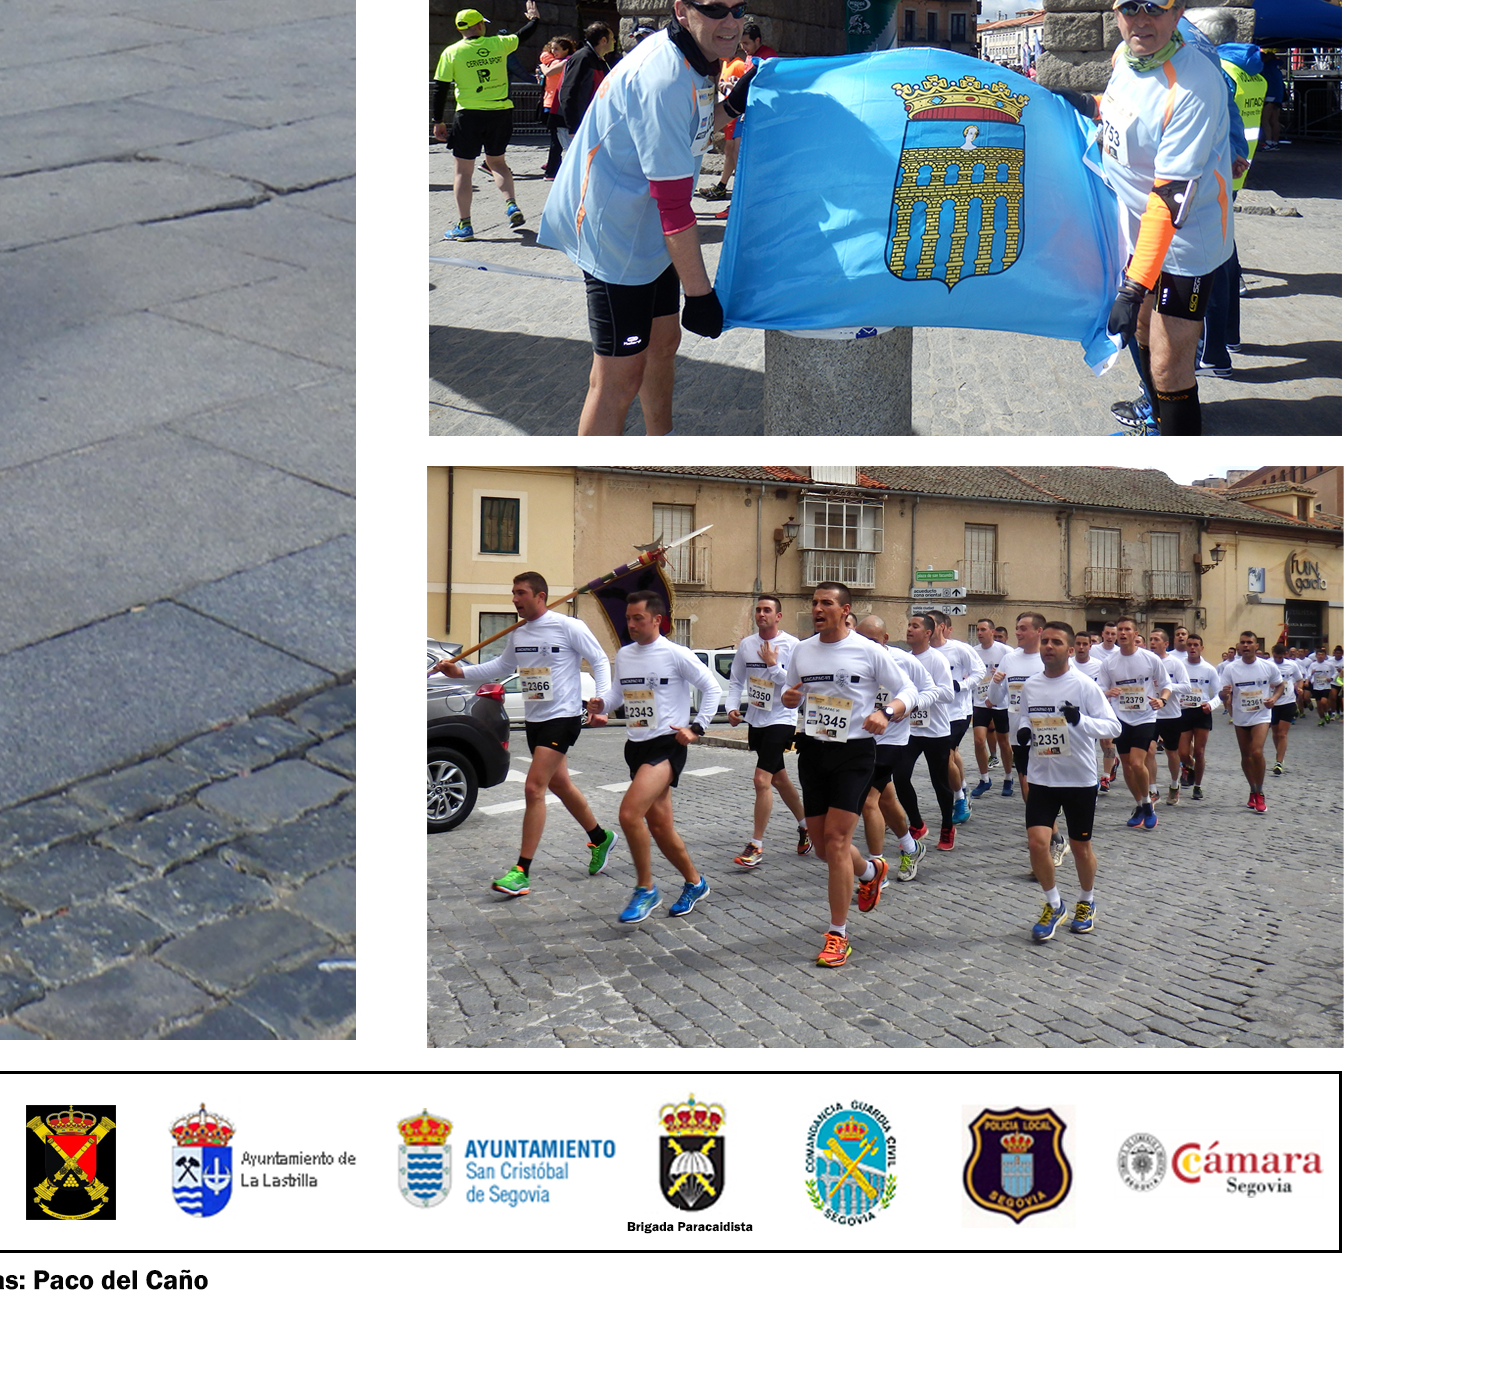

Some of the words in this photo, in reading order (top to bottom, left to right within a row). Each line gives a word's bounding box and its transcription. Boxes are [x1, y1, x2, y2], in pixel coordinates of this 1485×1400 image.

[1104, 120, 1120, 147] 753
[527, 681, 550, 691] 2366
[752, 689, 771, 701] 2350
[876, 692, 889, 702] 47
[1125, 696, 1144, 704] 2379
[1246, 698, 1263, 706] 2361
[629, 706, 654, 718] 2343
[1038, 733, 1065, 746] 2351
